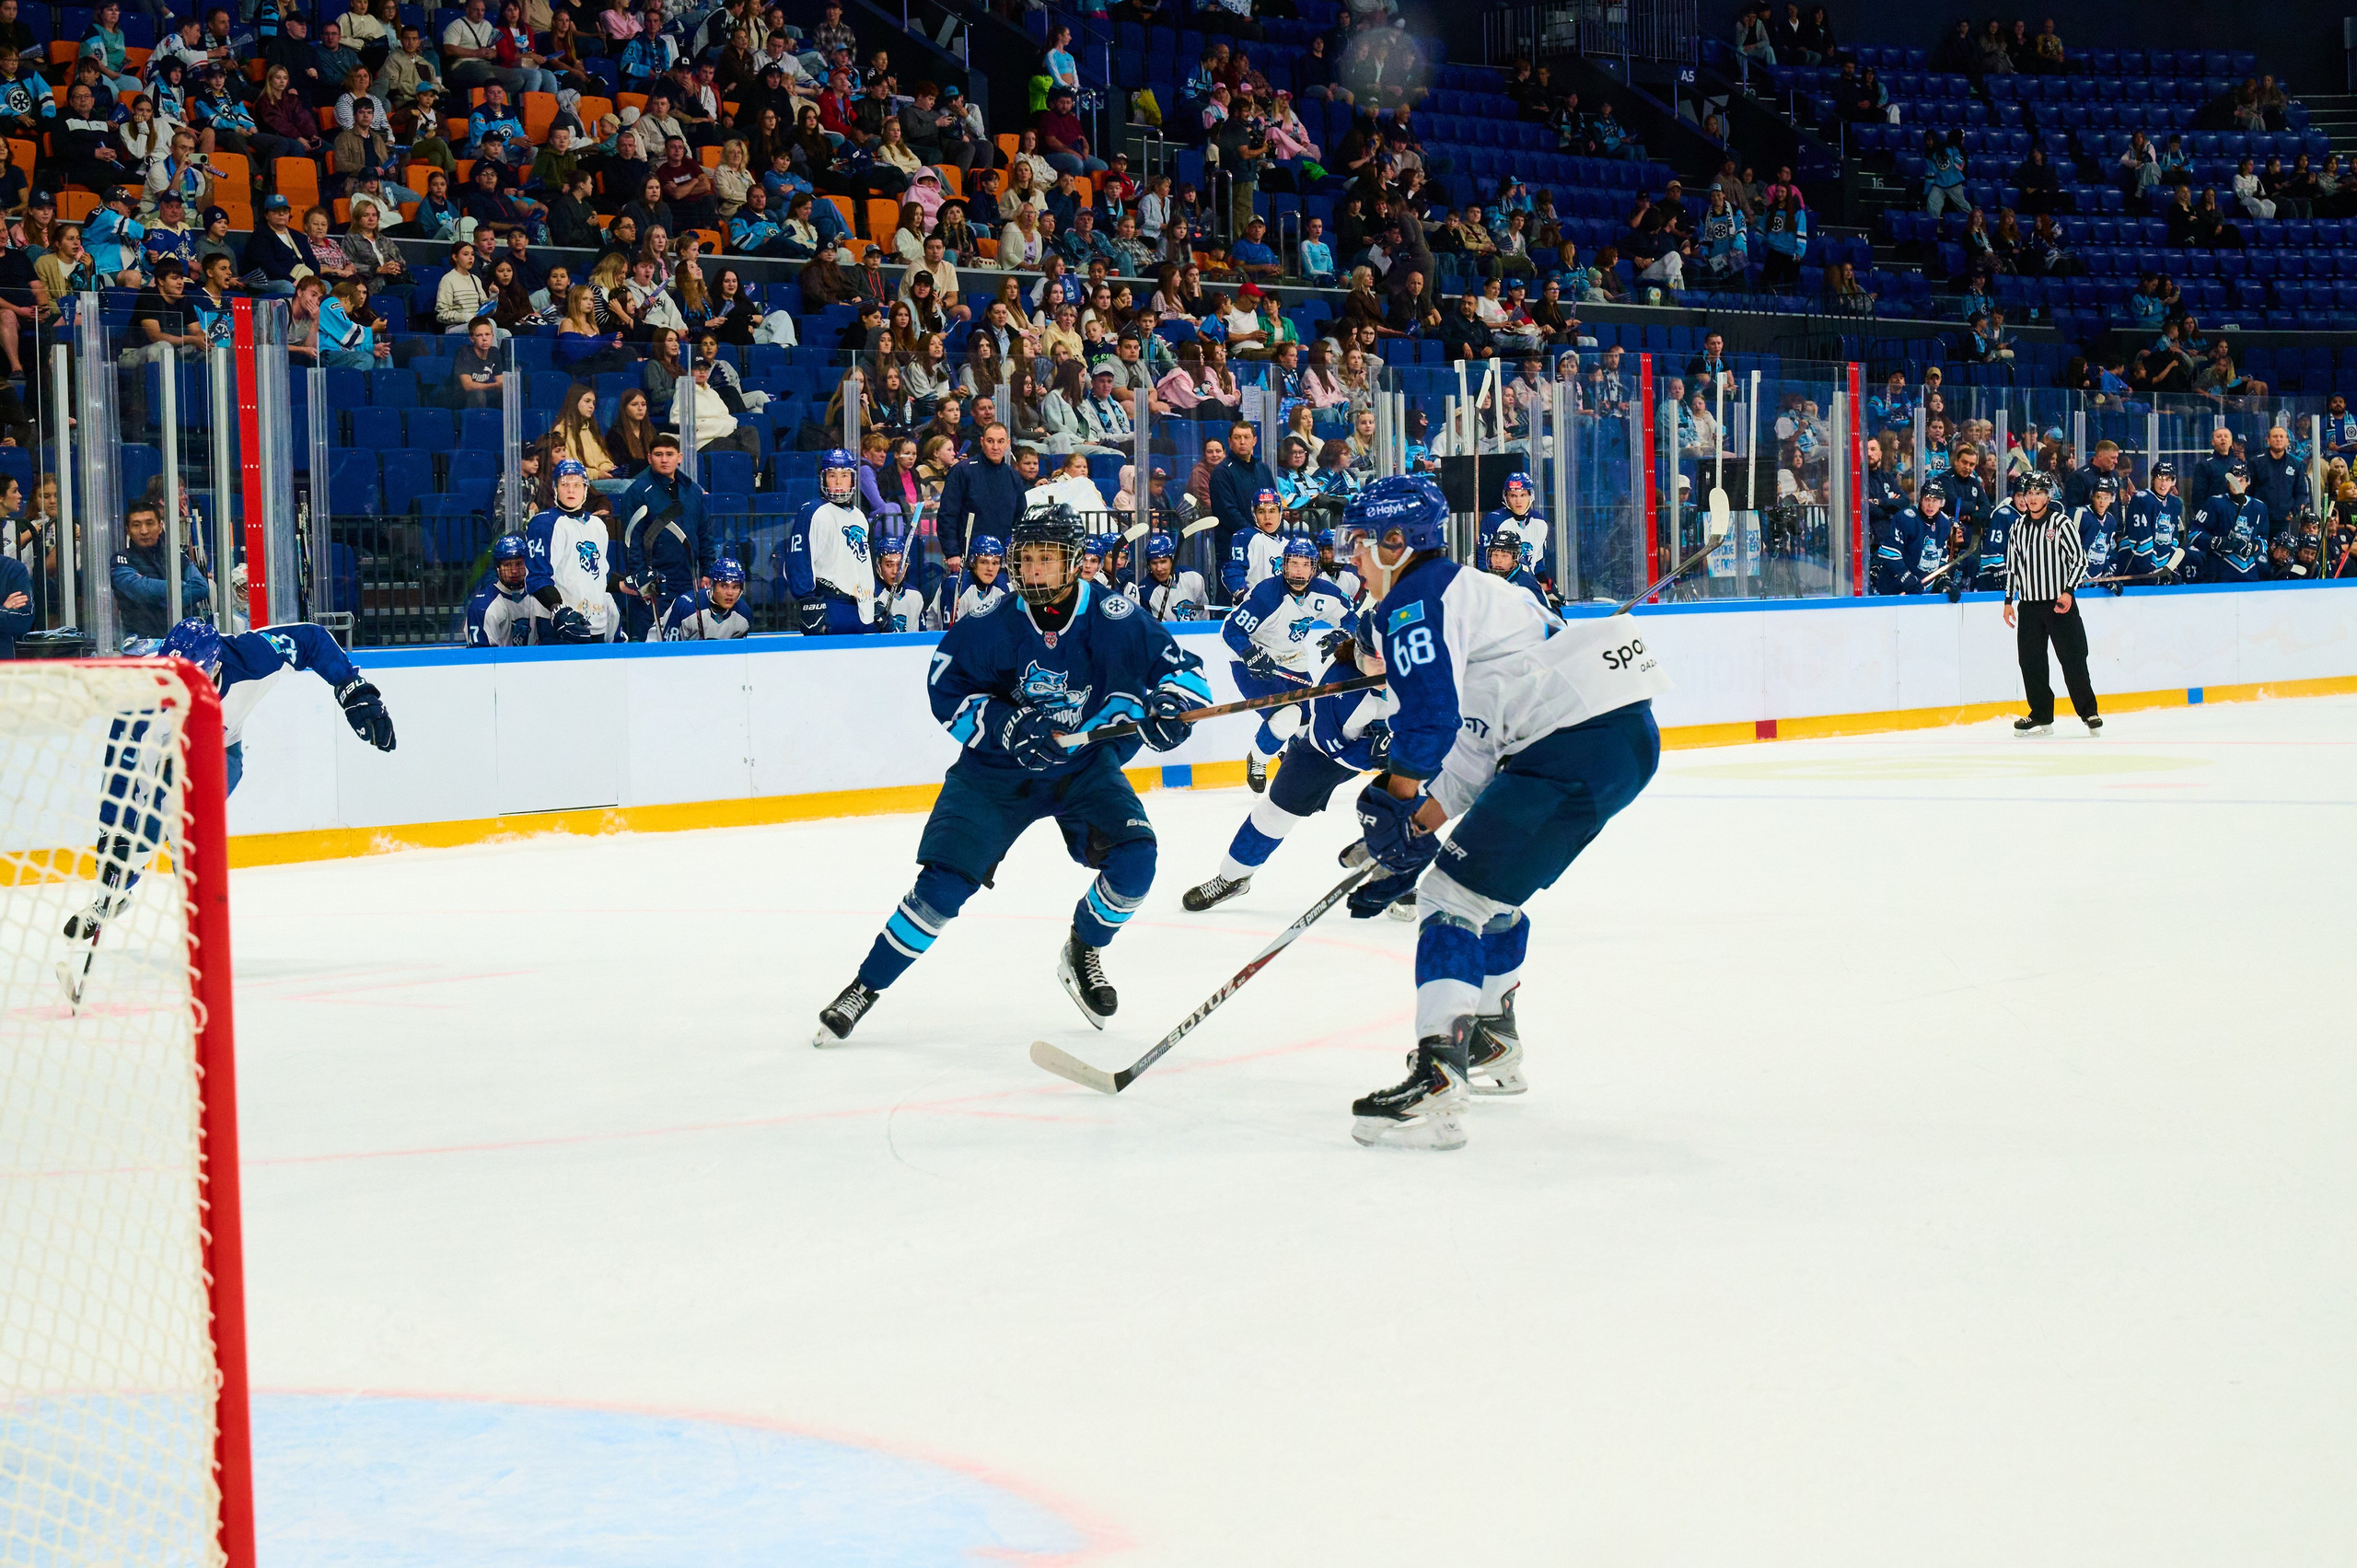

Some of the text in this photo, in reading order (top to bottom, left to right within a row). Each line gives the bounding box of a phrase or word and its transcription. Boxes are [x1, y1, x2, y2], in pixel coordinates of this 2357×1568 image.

[1681, 70, 1695, 82] A5
[1872, 177, 1884, 188] 16
[1376, 503, 1405, 517] Halyk
[2132, 514, 2148, 527] 34
[790, 533, 804, 553] 12
[1990, 528, 2003, 543] 13
[527, 538, 546, 559] 84
[1231, 546, 1245, 562] 13
[1129, 586, 1138, 598] A
[1314, 598, 1325, 612] C
[1235, 609, 1260, 633] 88
[1393, 626, 1436, 677] 68
[1602, 636, 1647, 670] Spo
[1290, 674, 1313, 687] CCM
[1002, 705, 1037, 751] BAUE
[1305, 900, 1327, 924] prime
[1167, 978, 1237, 1047] SOYUZ
